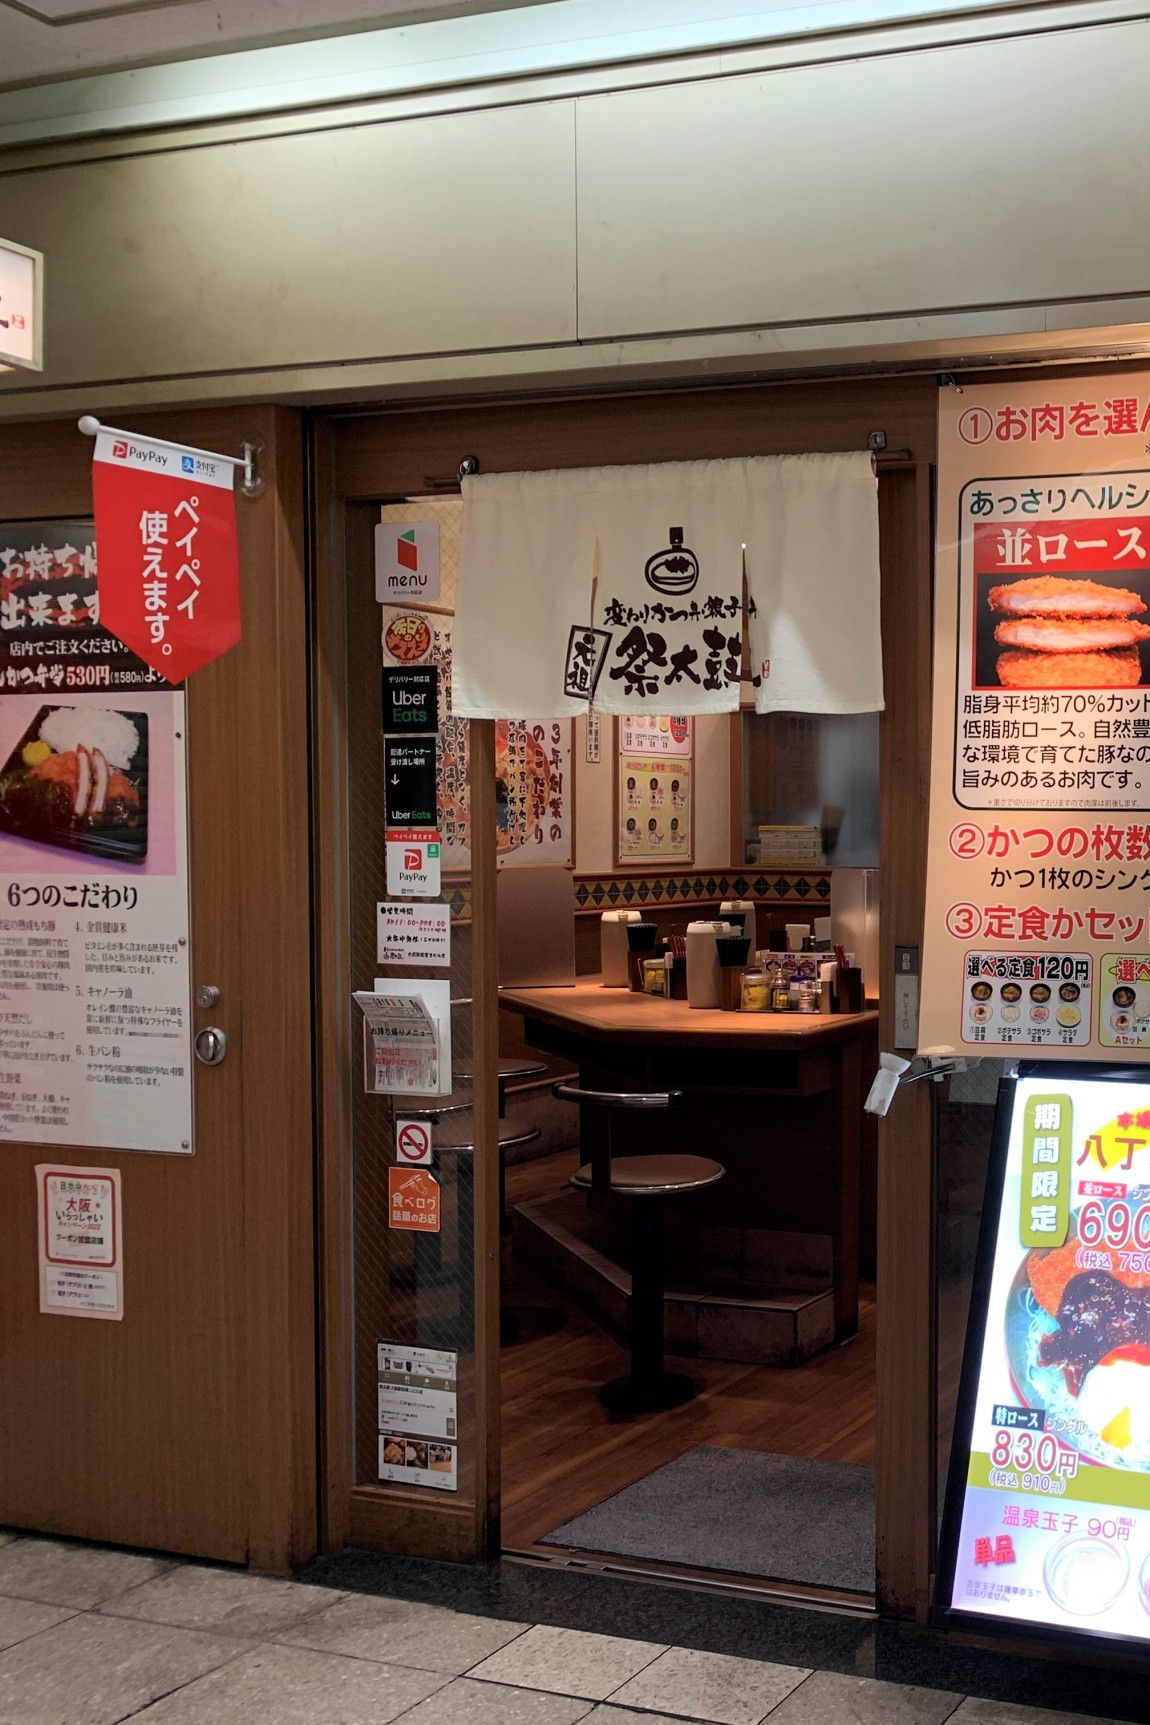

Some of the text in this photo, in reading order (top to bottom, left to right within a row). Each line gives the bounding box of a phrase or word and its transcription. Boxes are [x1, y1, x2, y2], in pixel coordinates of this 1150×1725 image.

[129, 446, 168, 466] PayPay
[996, 526, 1147, 566] 並ロース
[174, 496, 201, 619] ペイペイ
[140, 510, 172, 655] 使えます。
[388, 574, 428, 587] menu
[393, 691, 426, 706] Uber
[393, 708, 427, 722] Eats
[962, 769, 1142, 789] 旨みのあるお肉です。
[392, 811, 431, 820] Uber Eats
[400, 872, 428, 882] PayPay
[8, 882, 138, 910] 6つのこだわり
[1115, 1036, 1142, 1045] Aセット
[1030, 1103, 1061, 1233] 期間限定
[1083, 1183, 1124, 1197] 並ロース
[66, 1198, 91, 1212] 大阪
[393, 1193, 437, 1208] 食べログ
[56, 1211, 103, 1222] いらっしゃい
[995, 1408, 1088, 1435] 特ロース シングル
[991, 1430, 1079, 1478] 830円
[1023, 1474, 1066, 1494] 910円)
[1002, 1505, 1130, 1541] 温泉玉子 90円
[974, 1535, 1016, 1567] 単品
